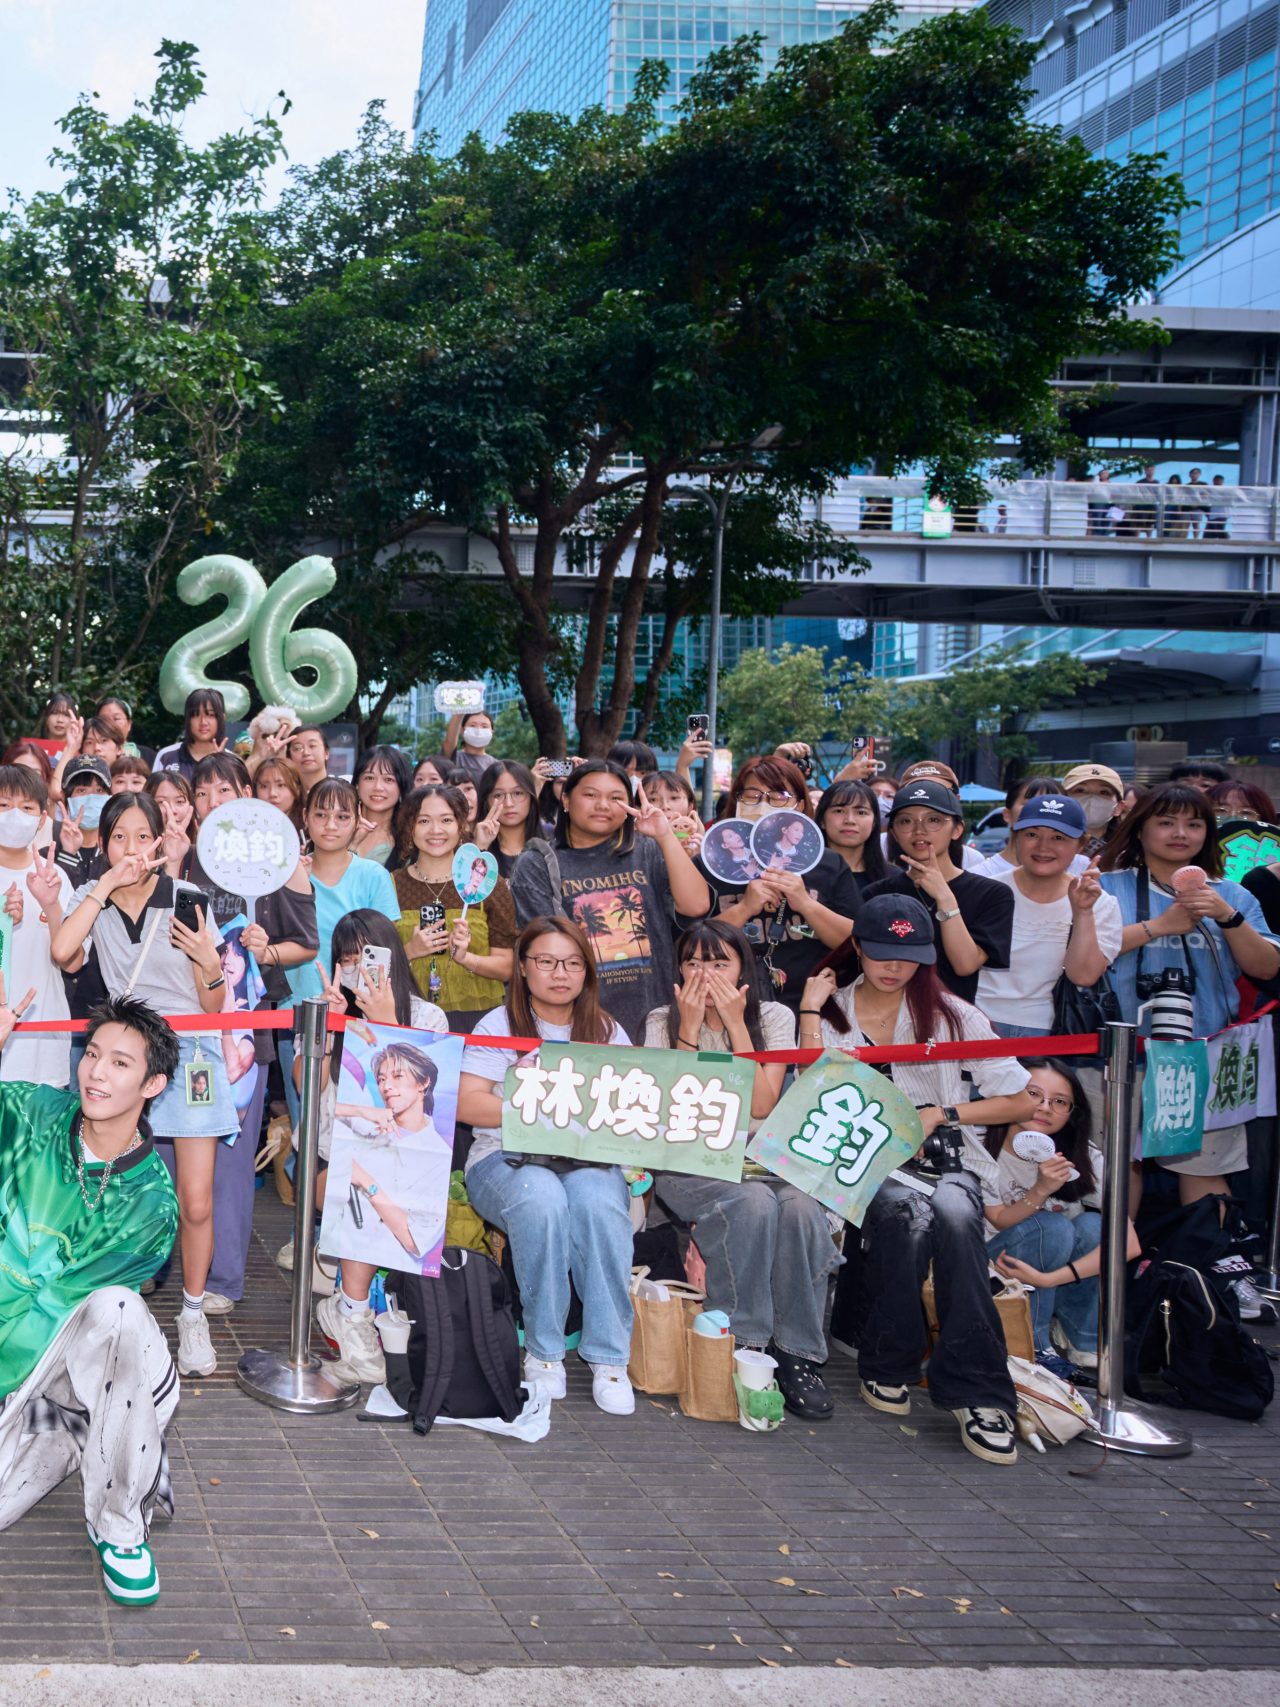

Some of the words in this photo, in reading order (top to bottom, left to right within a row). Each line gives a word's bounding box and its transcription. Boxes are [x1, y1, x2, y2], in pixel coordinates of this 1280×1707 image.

[160, 555, 358, 722] 26
[511, 1056, 742, 1151] 林煥鈞
[788, 1082, 893, 1187] 鈞
